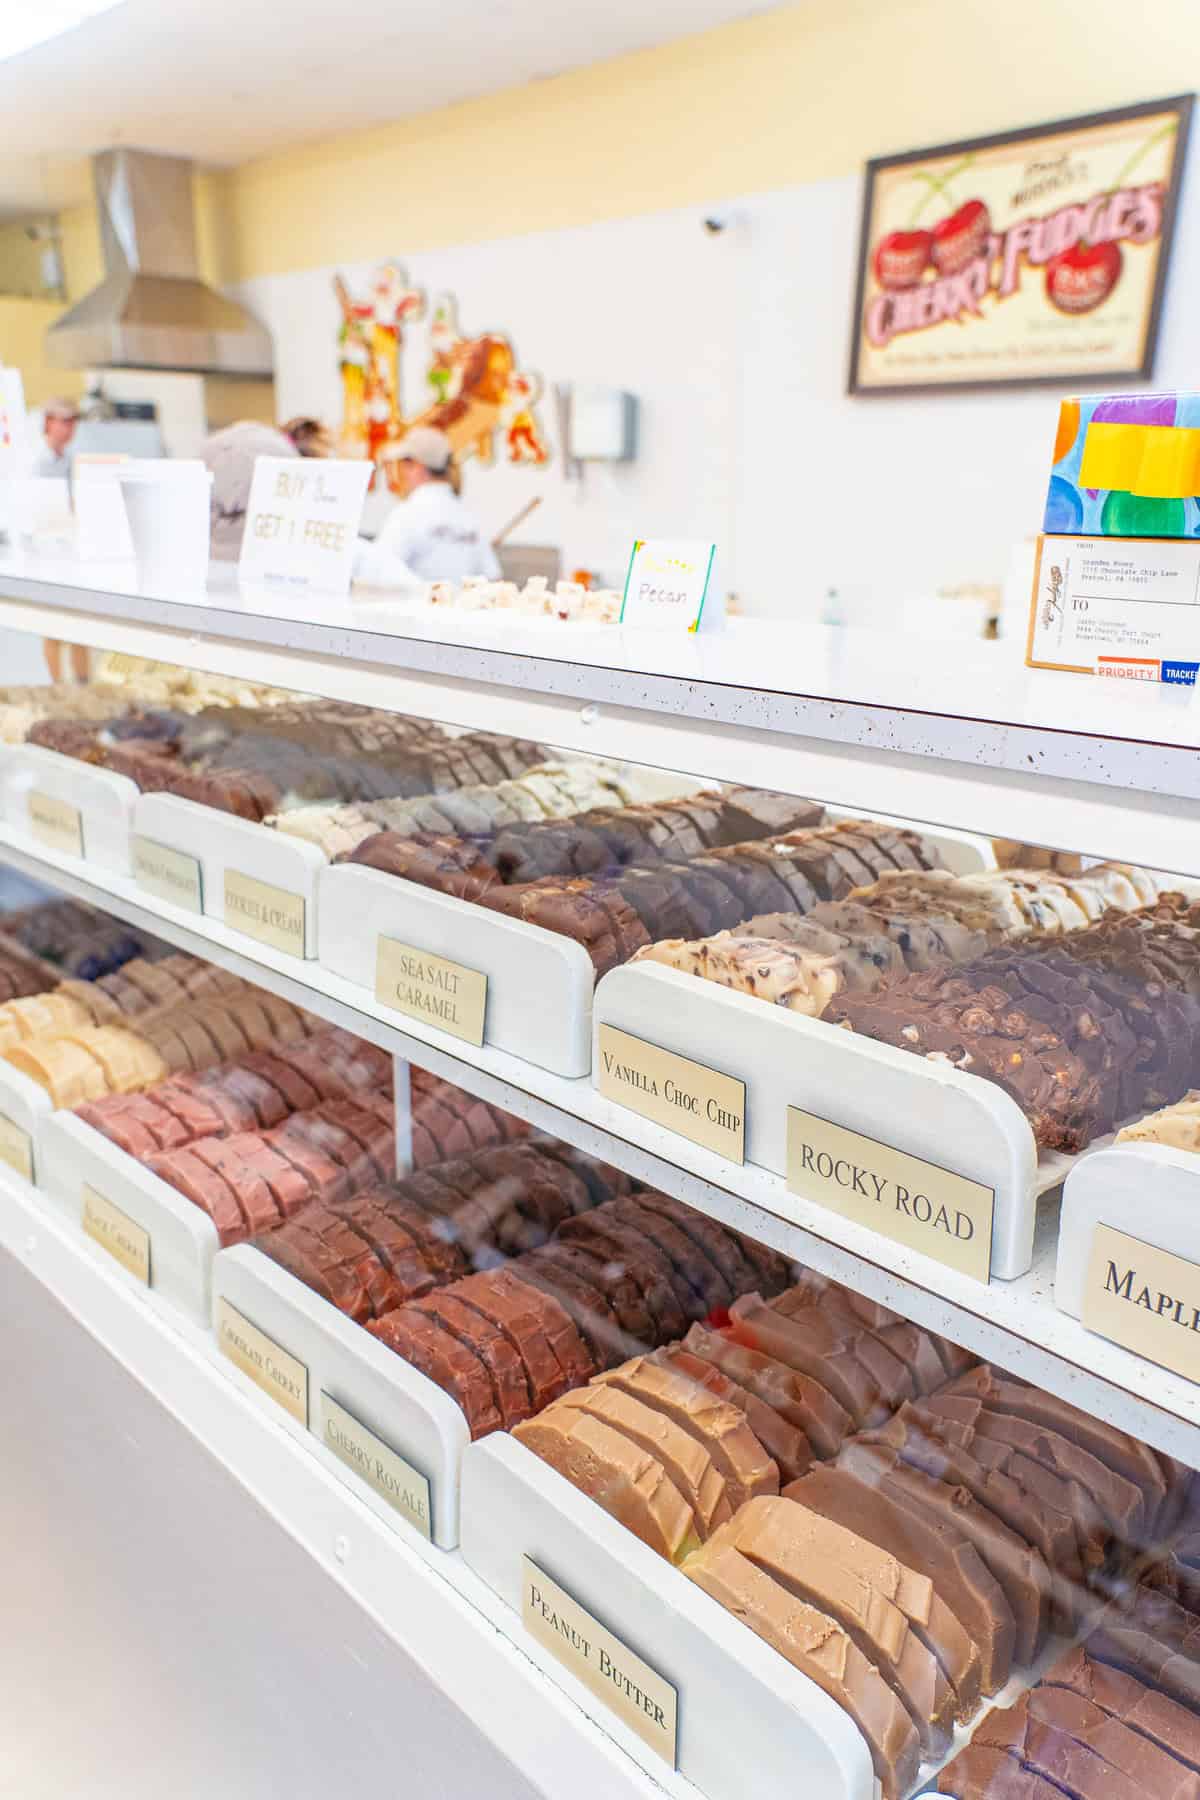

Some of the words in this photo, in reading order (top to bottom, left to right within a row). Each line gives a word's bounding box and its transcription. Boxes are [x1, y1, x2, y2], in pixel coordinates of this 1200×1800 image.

[255, 515, 285, 540] GET
[304, 521, 346, 553] FREE
[639, 583, 687, 603] Pecan
[1072, 600, 1089, 611] TO
[1098, 667, 1154, 679] PRIORITY
[400, 955, 424, 981] SEA
[427, 965, 463, 994] SALT
[396, 982, 461, 1025] CARAMEL
[602, 1051, 658, 1097] VANILLA
[664, 1079, 701, 1116] CHOC.
[706, 1098, 741, 1132] CHIP
[801, 1143, 888, 1202] ROCKY
[894, 1184, 975, 1241] ROAD
[327, 1417, 372, 1470] CHERRY
[375, 1460, 426, 1520] ROYALE
[530, 1584, 592, 1657] PEANUT
[599, 1646, 668, 1729] BUTTER
